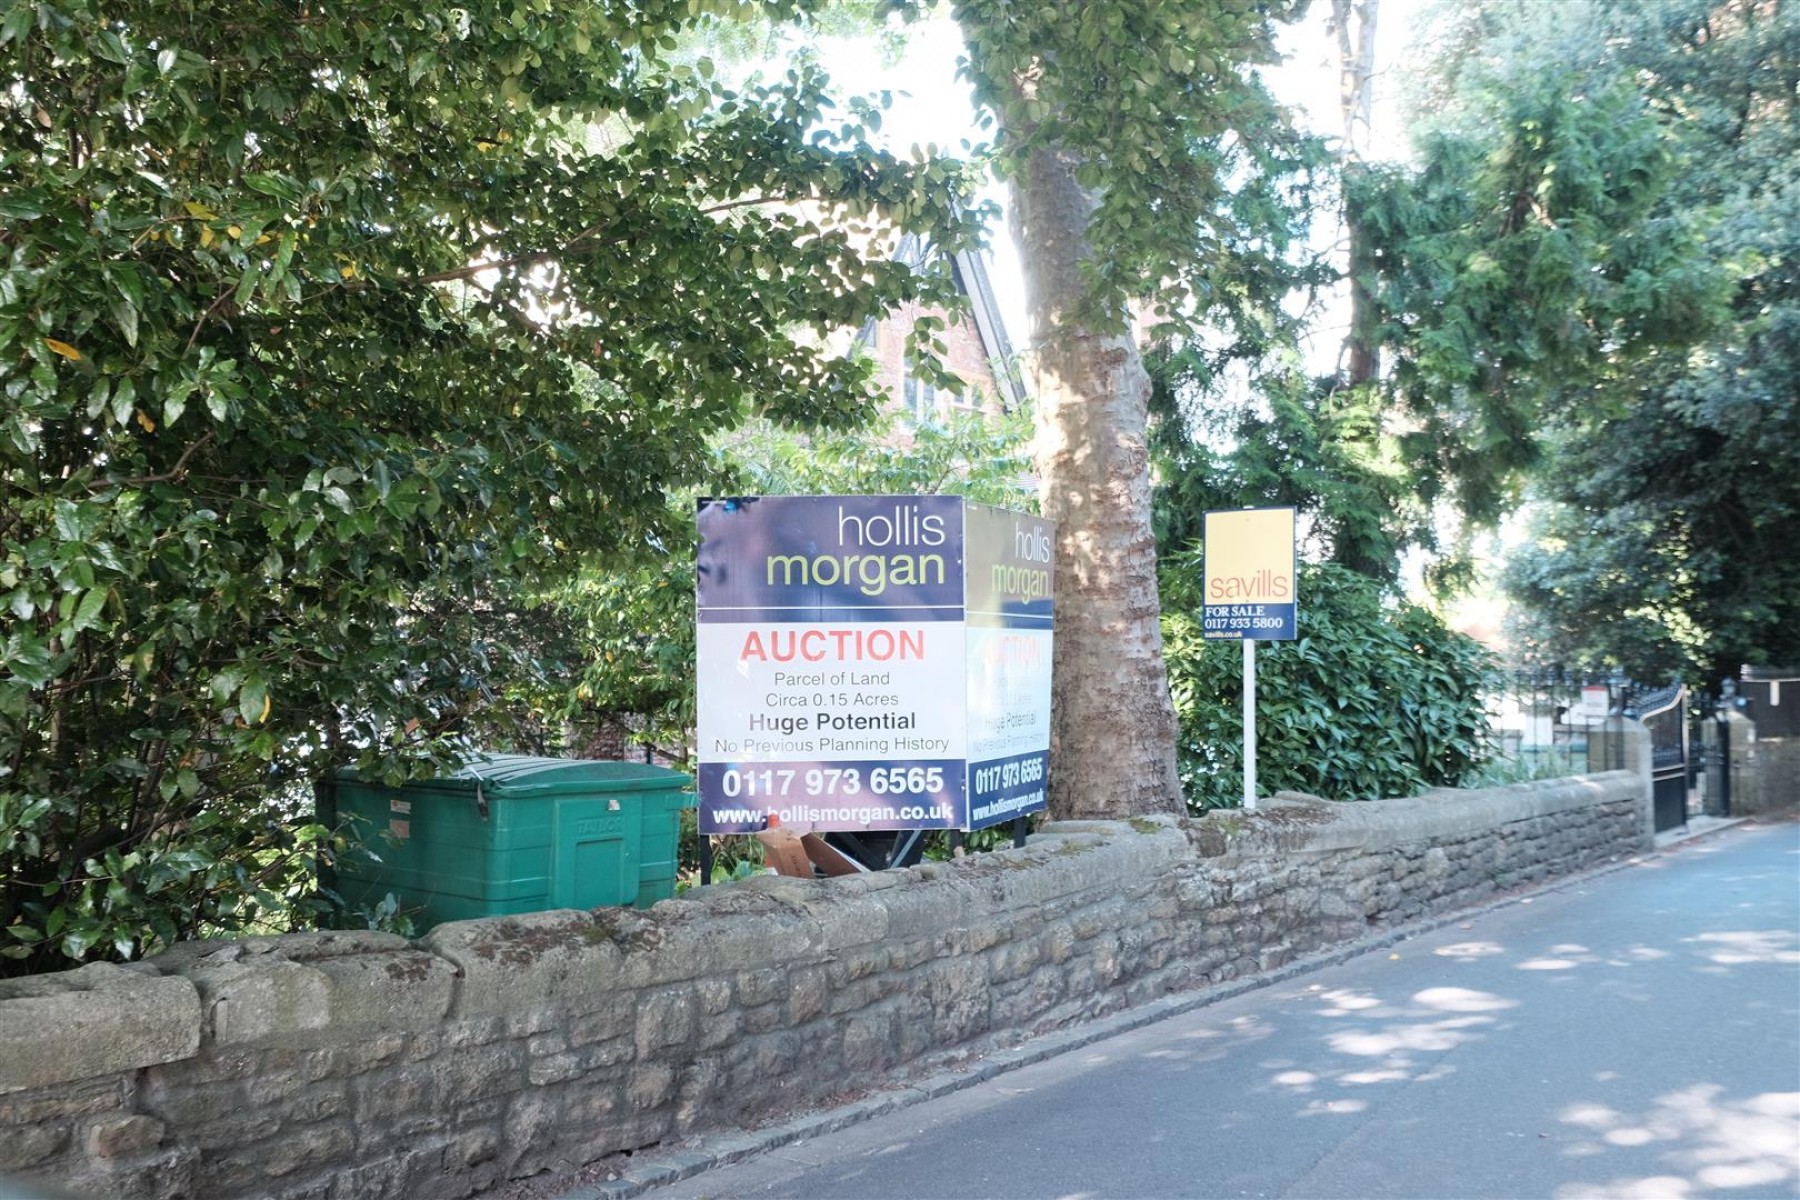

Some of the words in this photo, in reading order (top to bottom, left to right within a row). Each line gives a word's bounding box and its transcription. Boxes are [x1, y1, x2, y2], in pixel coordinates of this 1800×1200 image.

[839, 505, 945, 546] hollis
[1015, 521, 1050, 563] hollis
[767, 553, 945, 596] morgan
[991, 563, 1048, 605] morgan
[1210, 569, 1288, 599] savills
[1204, 618, 1228, 629] 0117
[1229, 618, 1251, 629] 933
[1252, 618, 1283, 629] 5800
[1205, 606, 1230, 618] FOR
[1231, 605, 1265, 617] SALE
[740, 629, 925, 662] AUCTION
[774, 672, 825, 687] Parcel
[830, 672, 846, 686] of
[850, 671, 890, 686] Land
[765, 693, 808, 707] Circa
[812, 693, 848, 707] 0.15
[853, 692, 899, 706] Acres
[750, 713, 809, 735] Huge
[817, 711, 916, 730] Potential
[715, 739, 738, 753] No
[743, 739, 814, 753] Previous
[819, 737, 889, 754] Planning
[894, 736, 949, 753] History
[722, 769, 796, 797] 0117
[805, 768, 860, 796] 973
[869, 766, 944, 795] 6565
[975, 765, 1001, 795] 0117
[1002, 761, 1019, 789] 973
[1020, 757, 1043, 784] 6565
